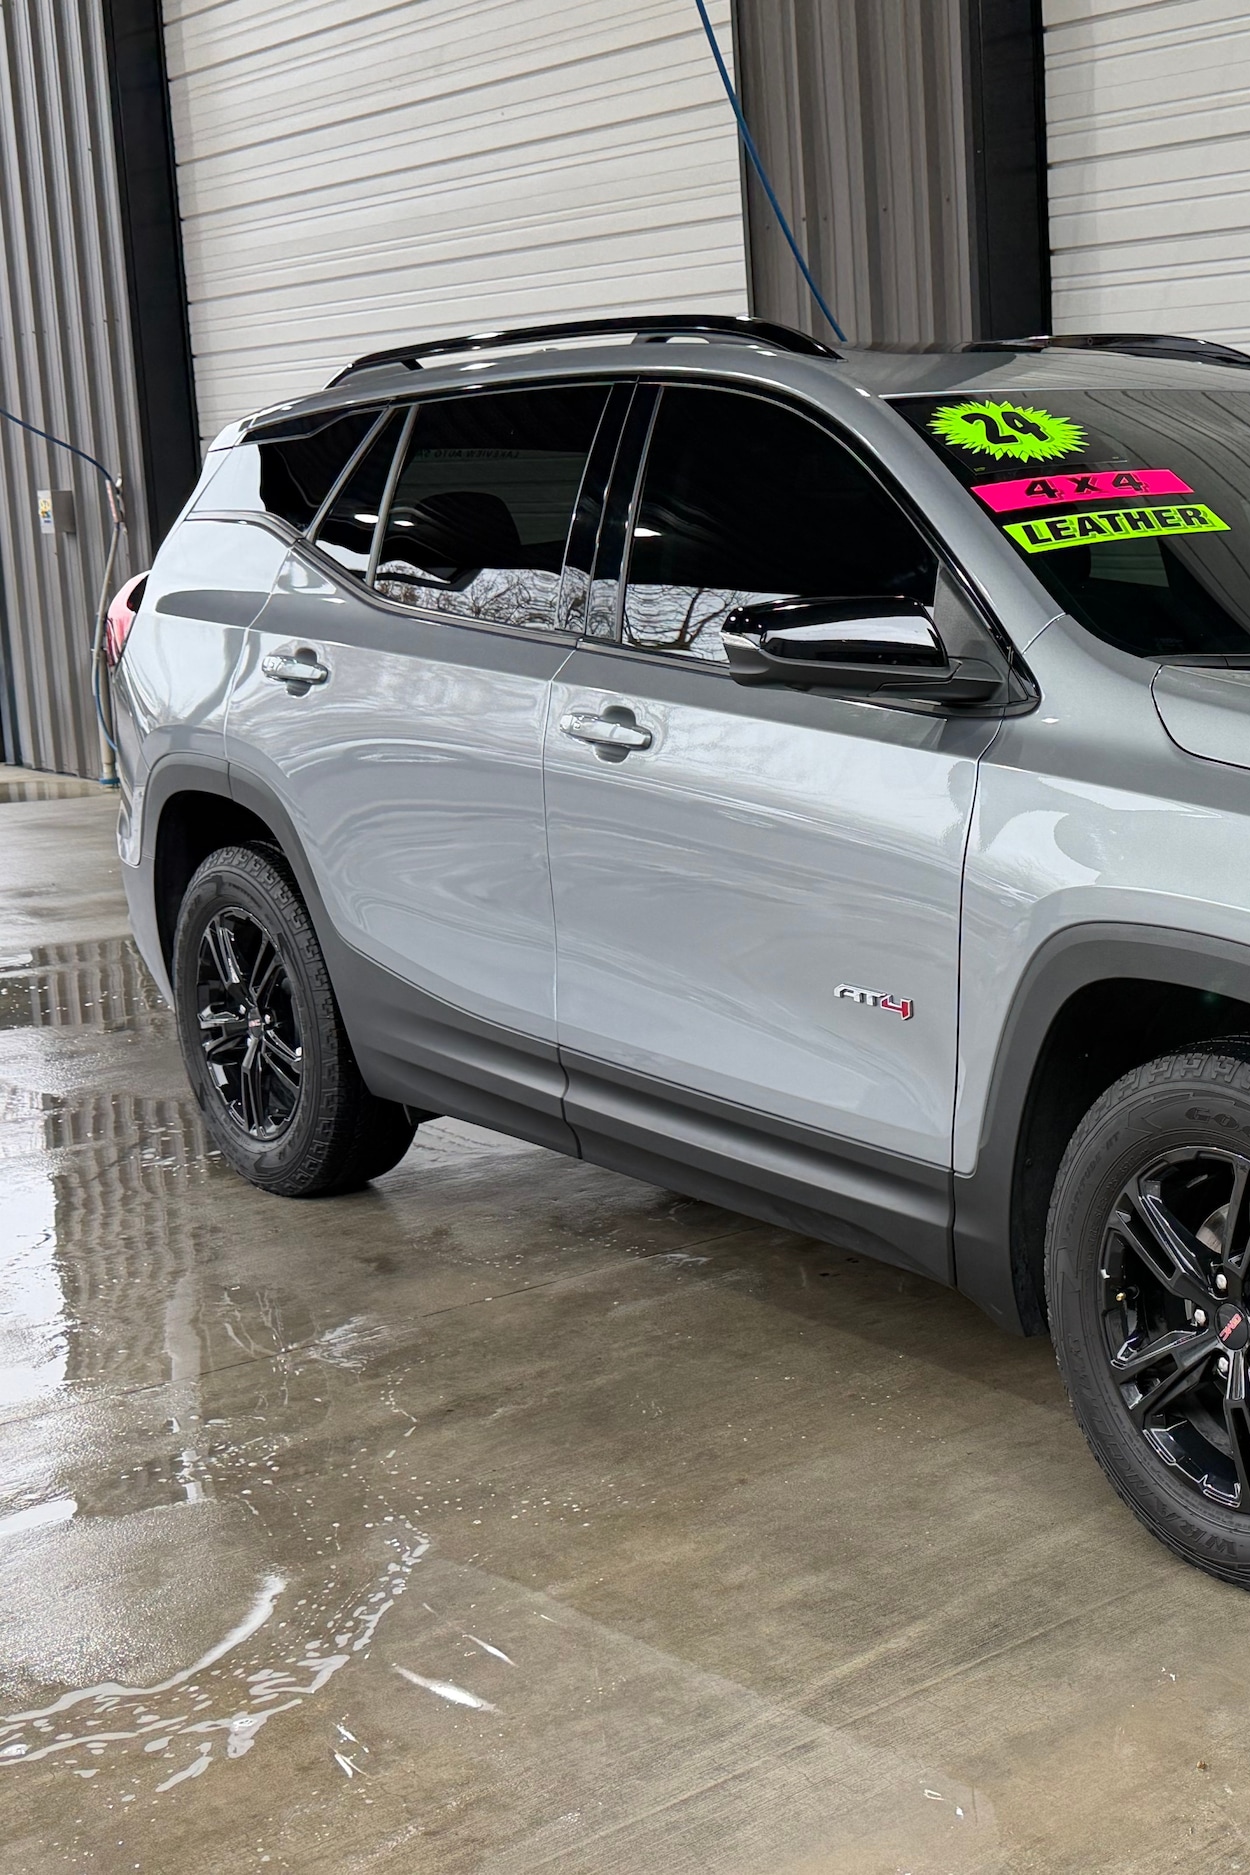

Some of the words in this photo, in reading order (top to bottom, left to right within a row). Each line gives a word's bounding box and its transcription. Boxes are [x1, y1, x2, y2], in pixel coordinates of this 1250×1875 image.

[961, 411, 1050, 445] 24
[1021, 507, 1210, 546] LEATHER
[834, 983, 914, 1021] AT4
